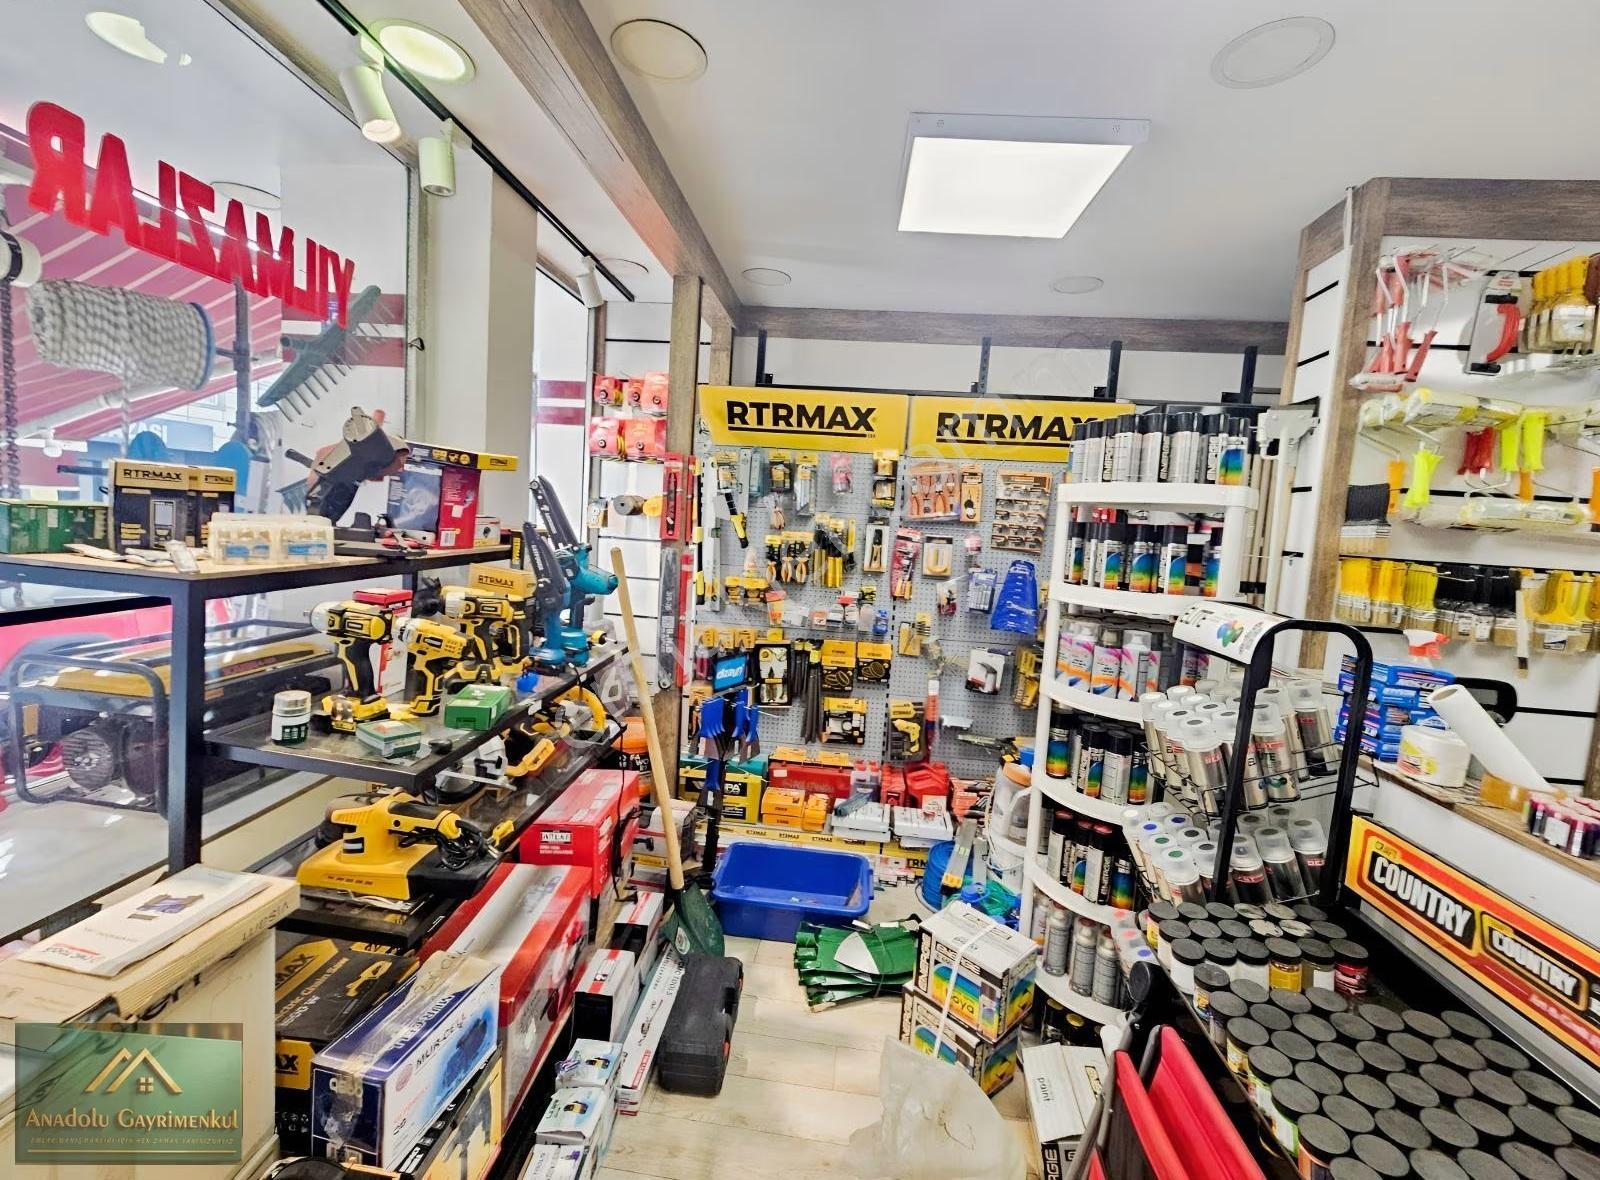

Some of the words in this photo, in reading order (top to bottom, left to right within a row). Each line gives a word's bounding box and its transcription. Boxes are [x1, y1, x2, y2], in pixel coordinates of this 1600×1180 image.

[726, 400, 877, 432] RTRMAX
[124, 469, 182, 481] RTRMAX
[478, 574, 514, 587] RTRMAX
[1373, 856, 1473, 938] COUNTRY
[1492, 930, 1577, 997] COUNTRY
[945, 987, 975, 1015] oya
